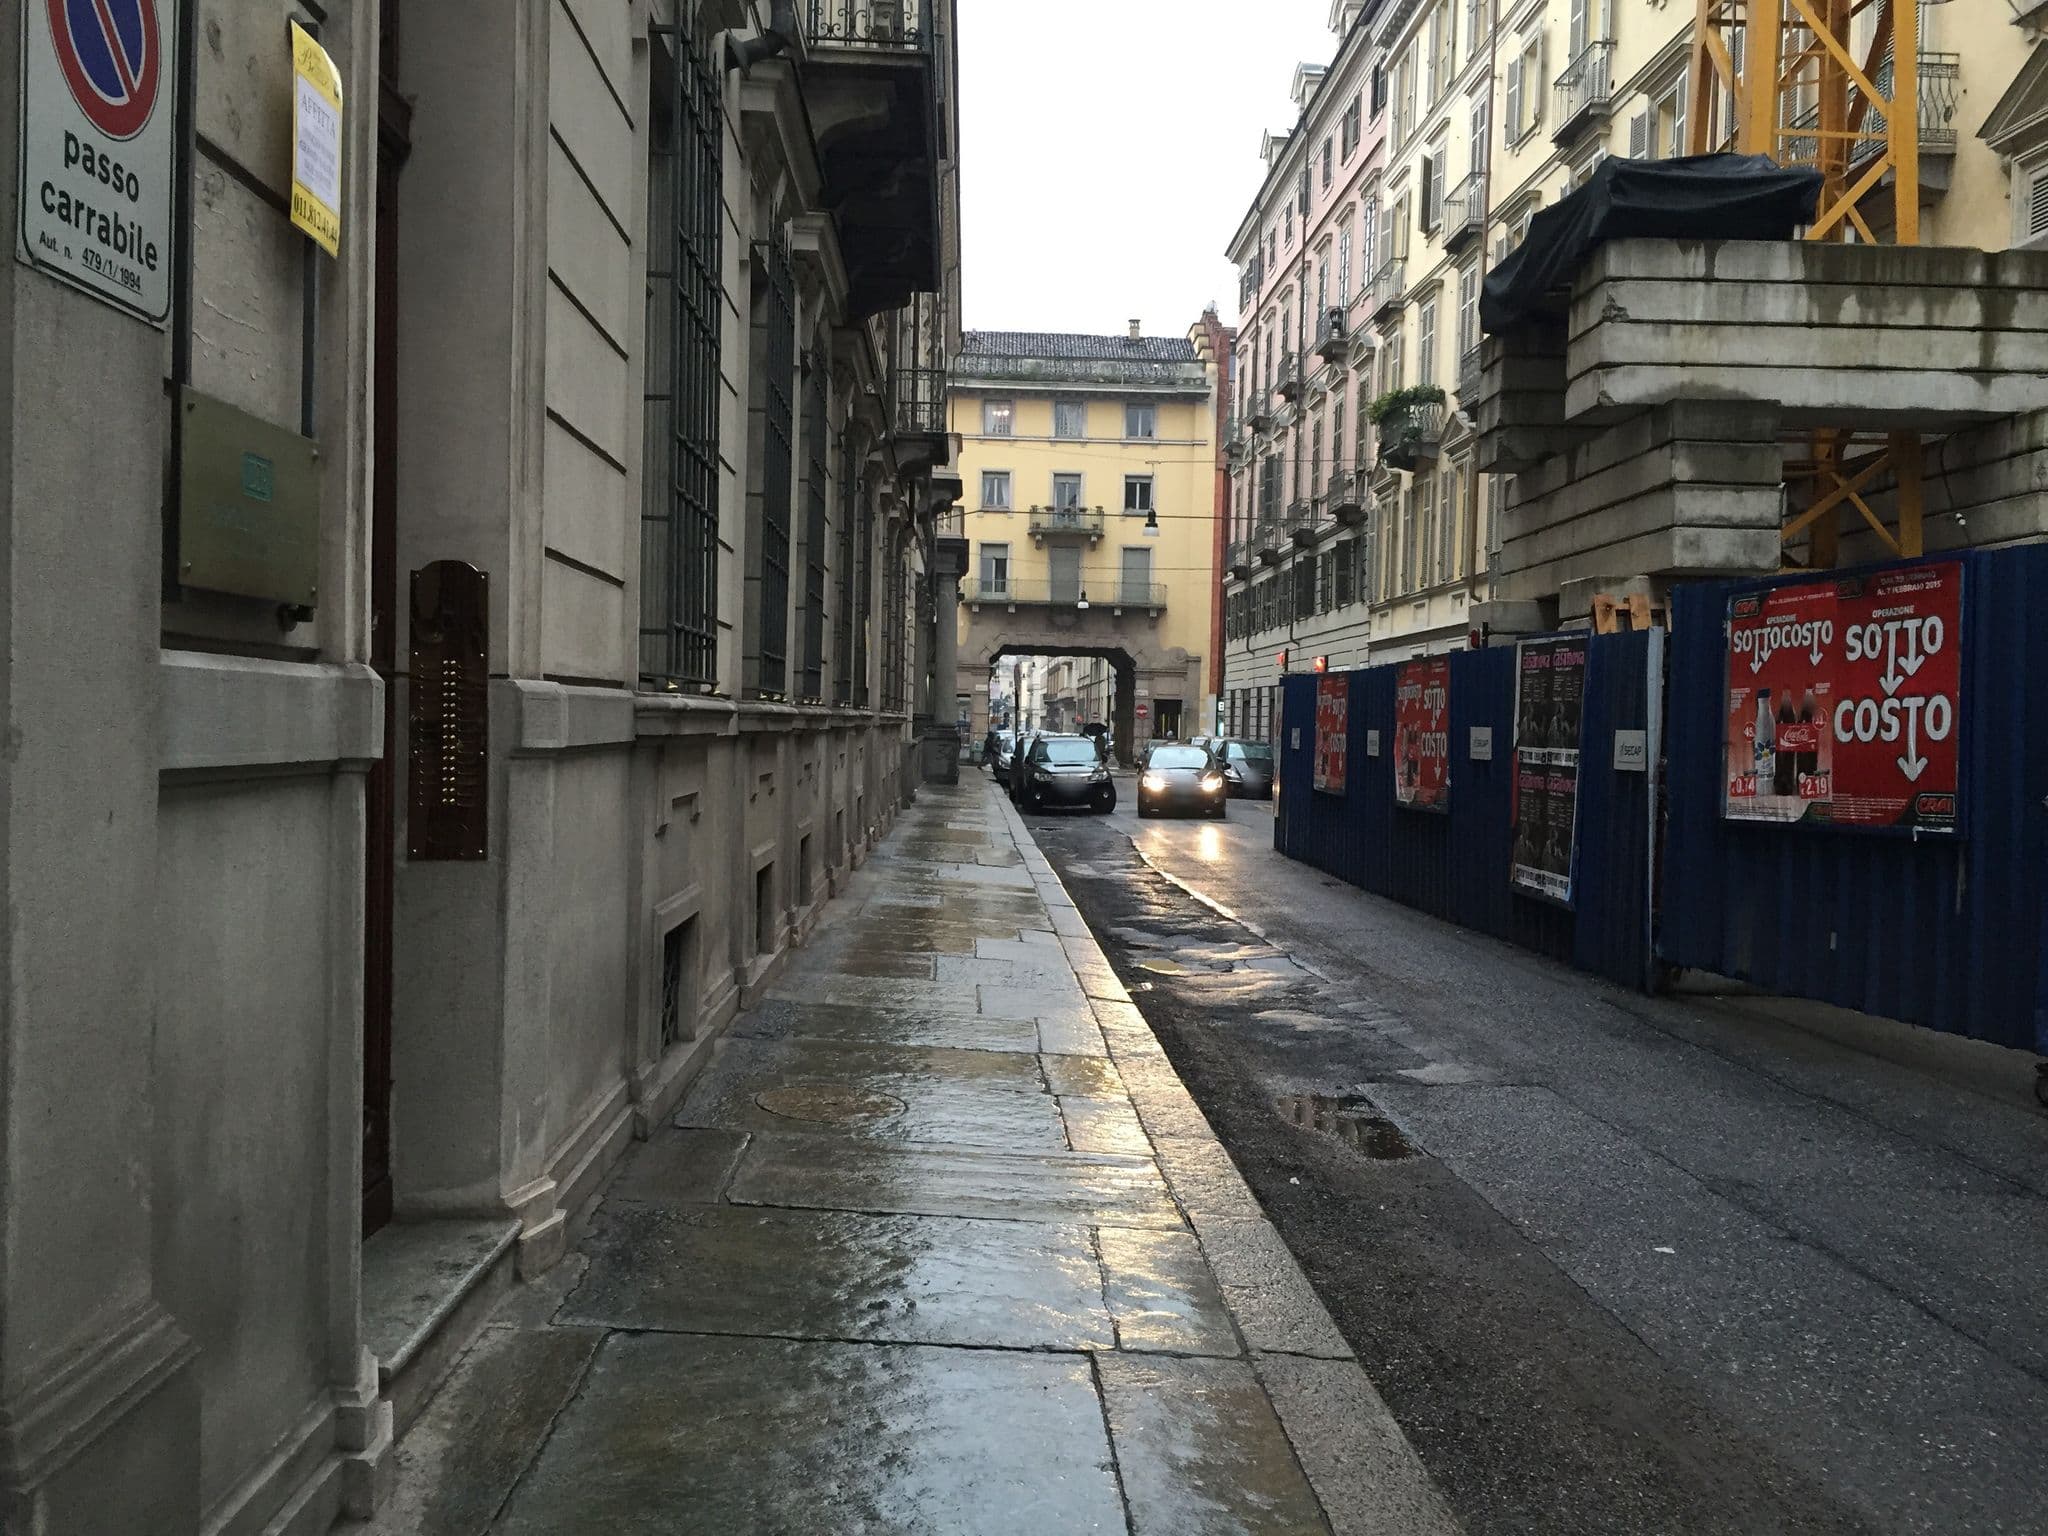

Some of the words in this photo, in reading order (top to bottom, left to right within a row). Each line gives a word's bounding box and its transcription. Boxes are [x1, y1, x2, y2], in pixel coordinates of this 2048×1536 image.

[64, 129, 139, 202] passo
[40, 181, 157, 271] carrabile
[39, 231, 58, 252] Aut.
[64, 245, 72, 260] n.
[1872, 604, 1915, 618] OPERAZIONE
[1733, 619, 1833, 654] SOTTOCOSTO
[1845, 615, 1944, 663] SOTTO
[1423, 687, 1446, 711] SOTTO
[1834, 694, 1952, 743] COSTO
[1421, 731, 1447, 758] COSTO
